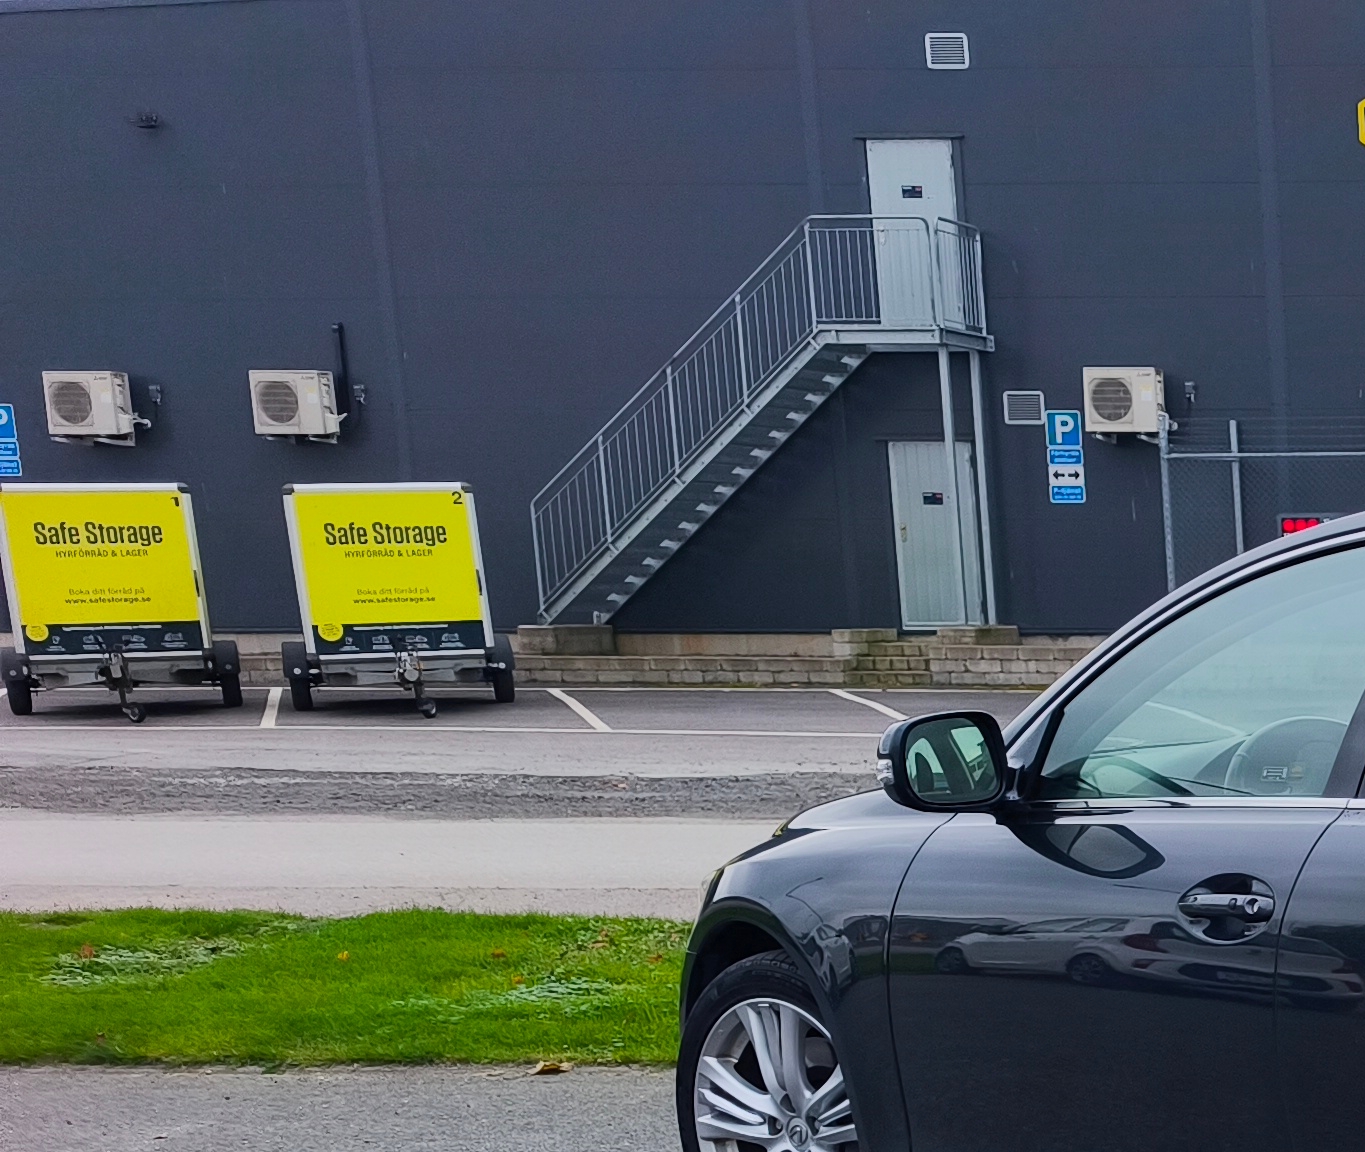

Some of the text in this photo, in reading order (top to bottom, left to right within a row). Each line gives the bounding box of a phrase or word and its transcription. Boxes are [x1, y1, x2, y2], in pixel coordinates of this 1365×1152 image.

[1054, 414, 1075, 444] P
[451, 491, 463, 505] 2
[33, 521, 163, 547] Safe Storage
[324, 521, 447, 547] Safe Storage
[120, 549, 148, 557] LAGER
[406, 549, 433, 557] LAGER
